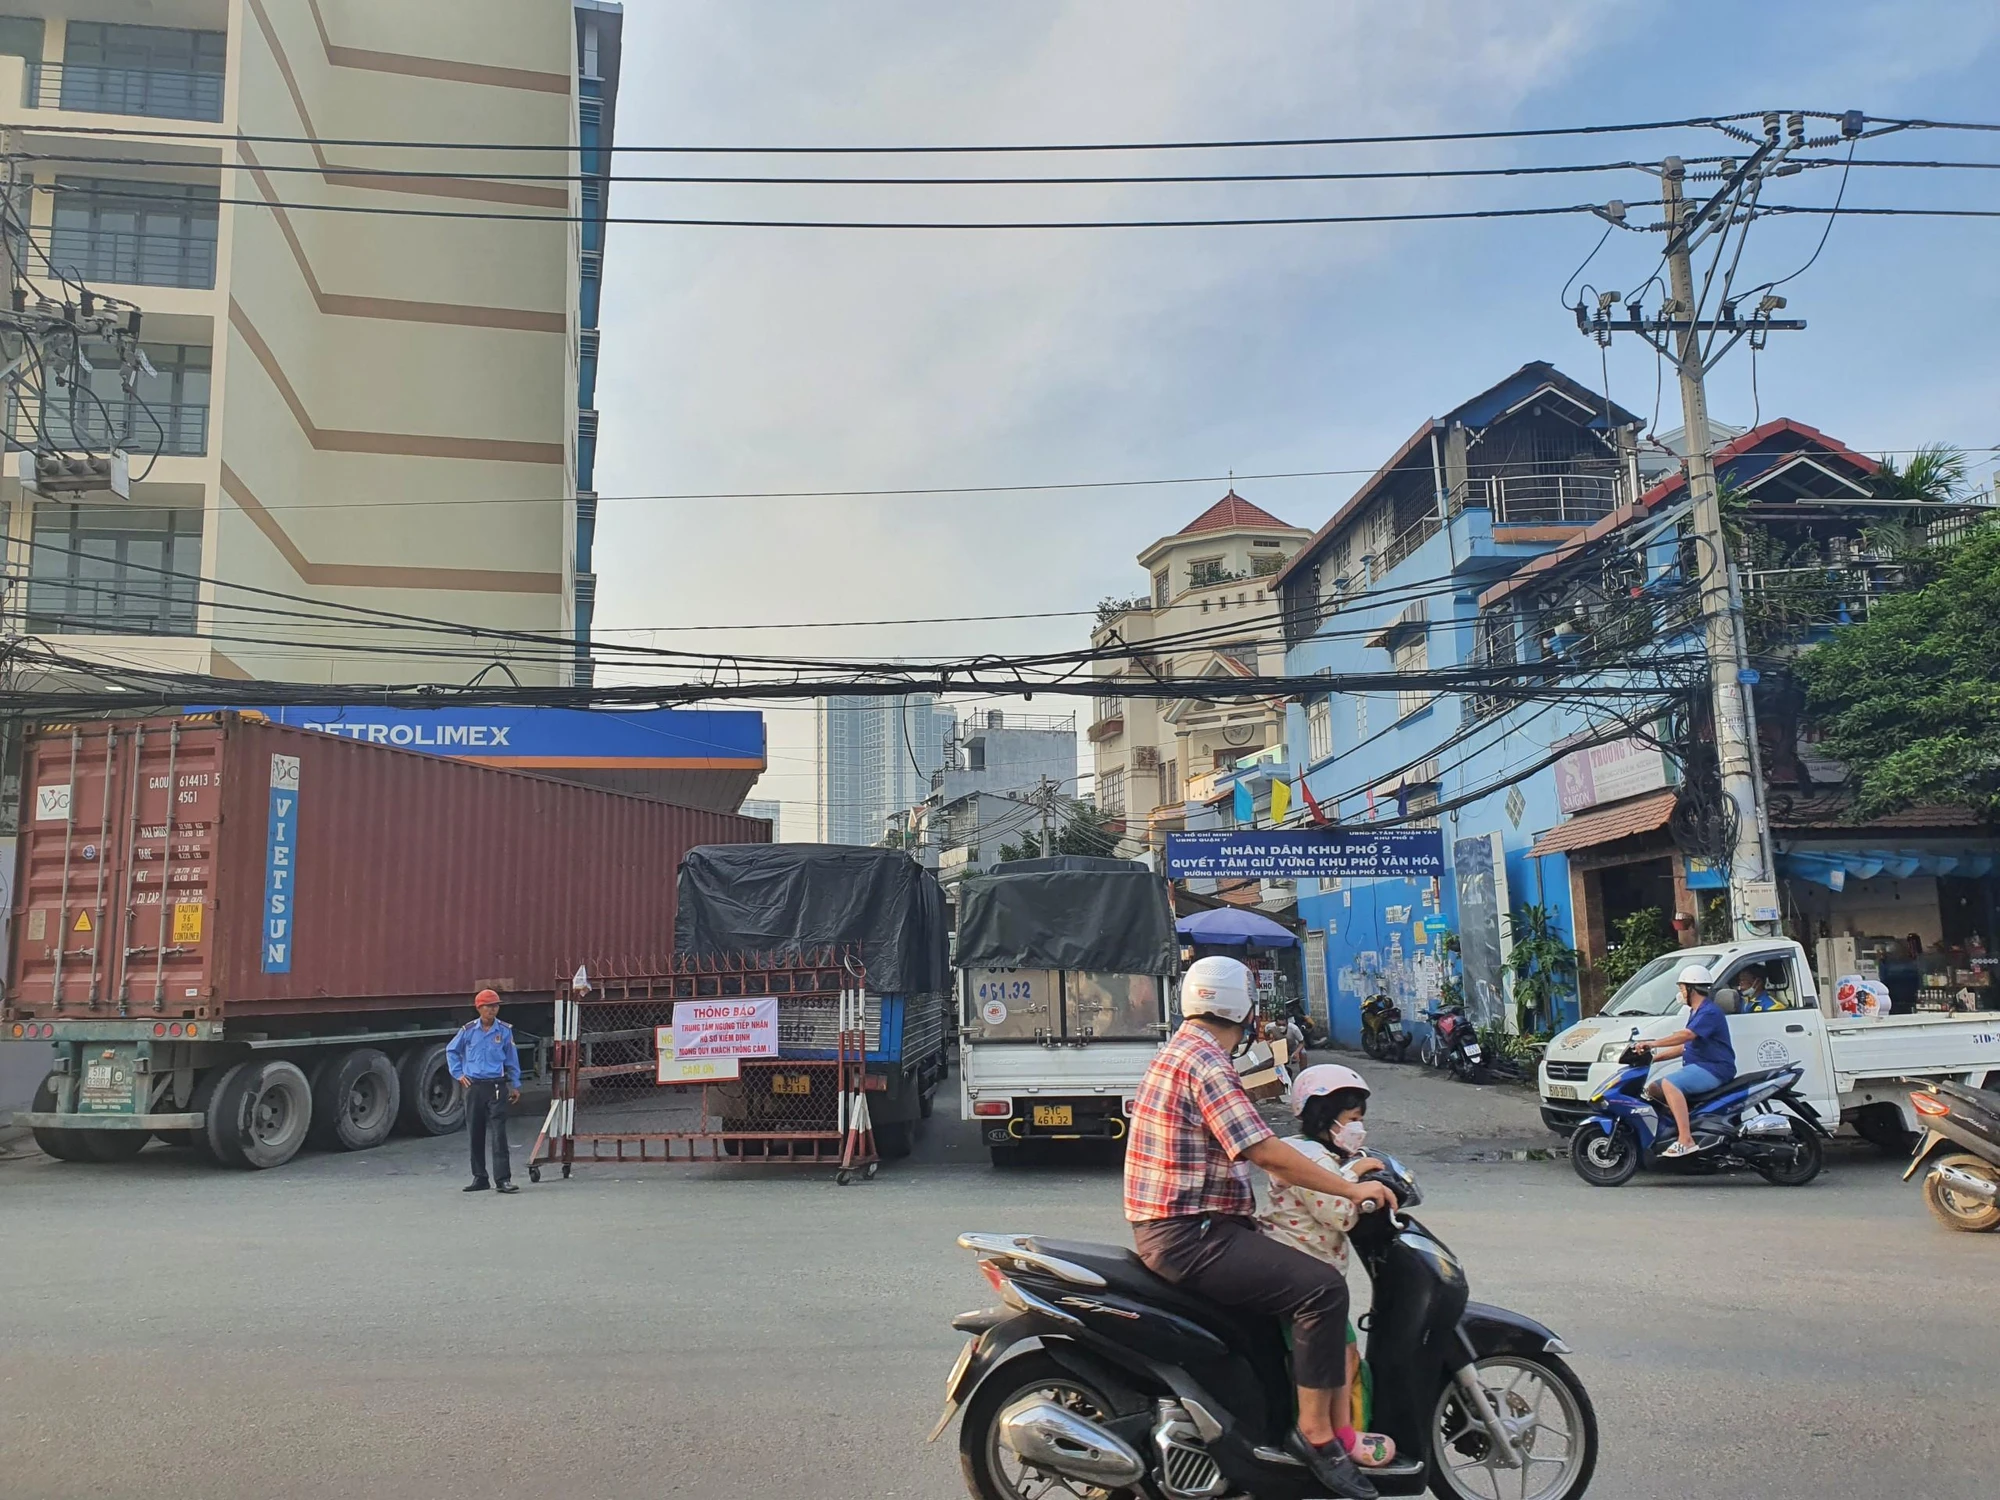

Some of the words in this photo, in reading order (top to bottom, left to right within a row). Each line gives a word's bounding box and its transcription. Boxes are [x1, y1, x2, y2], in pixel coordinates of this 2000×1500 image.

[149, 776, 169, 789] GAOU
[179, 774, 208, 787] 614413
[214, 772, 220, 786] 5
[178, 791, 198, 803] 45G1
[138, 848, 152, 859] TARE
[1220, 845, 1265, 855] NHÂN
[1270, 845, 1303, 855] DÂN
[1308, 846, 1341, 855] KHU
[1345, 842, 1378, 854] PHỐ
[1382, 845, 1392, 854] 2
[1171, 856, 1215, 868] QUYẾT
[1219, 857, 1247, 867] TÂM
[1251, 856, 1275, 867] GIỮ
[1278, 856, 1315, 867] VỮNG
[1320, 858, 1347, 867] KHU
[1351, 854, 1378, 866] PHỐ
[1381, 855, 1409, 866] VĂN
[1412, 854, 1440, 866] HÓA
[137, 871, 148, 881] NET
[268, 798, 292, 964] VIETSUN
[178, 905, 199, 913] CAUTION
[181, 923, 194, 931] HIGH
[174, 932, 200, 941] CONTAINER
[979, 981, 1031, 1000] 461.32
[693, 1005, 730, 1018] THÔNG
[733, 1004, 756, 1017] BÁO
[681, 1024, 701, 1032] TRUNG
[702, 1023, 714, 1031] TÂM
[711, 1045, 731, 1054] KHÁCH
[732, 1044, 751, 1054] THÔNG
[1043, 1106, 1062, 1115] 51C
[1037, 1115, 1069, 1125] 461.32
[991, 1131, 1009, 1140] KIA
